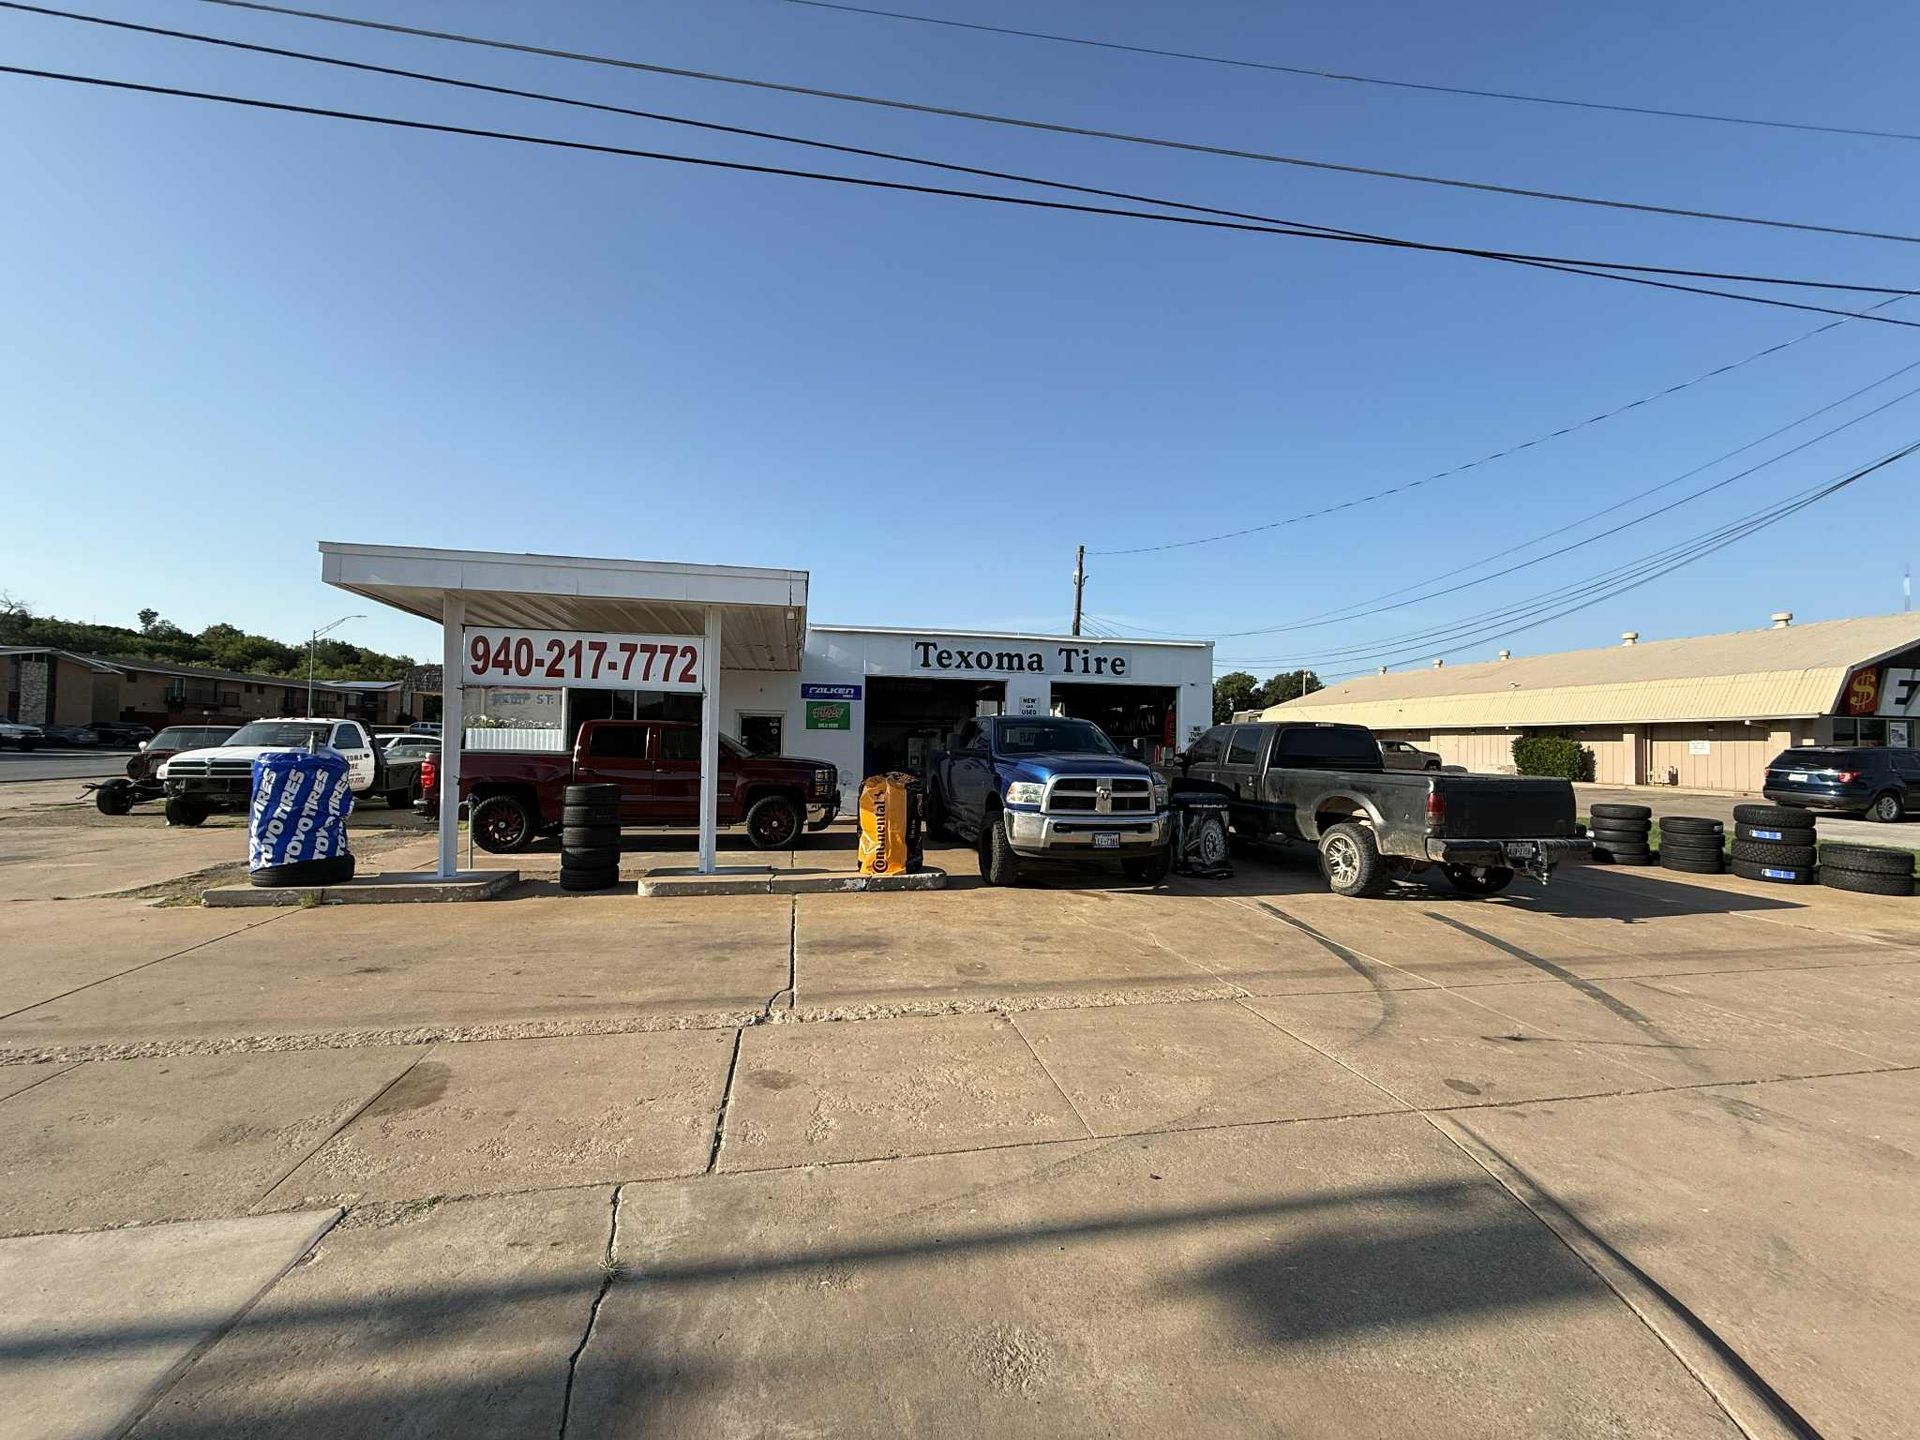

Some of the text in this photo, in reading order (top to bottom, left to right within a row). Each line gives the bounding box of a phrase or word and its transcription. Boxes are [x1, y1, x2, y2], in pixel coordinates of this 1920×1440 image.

[470, 635, 698, 683] 940-217-7772
[914, 641, 1126, 675] Texoma Tire
[808, 687, 855, 695] FALKEN
[272, 768, 305, 821] TIRES
[283, 768, 329, 865] TOYO TIRES
